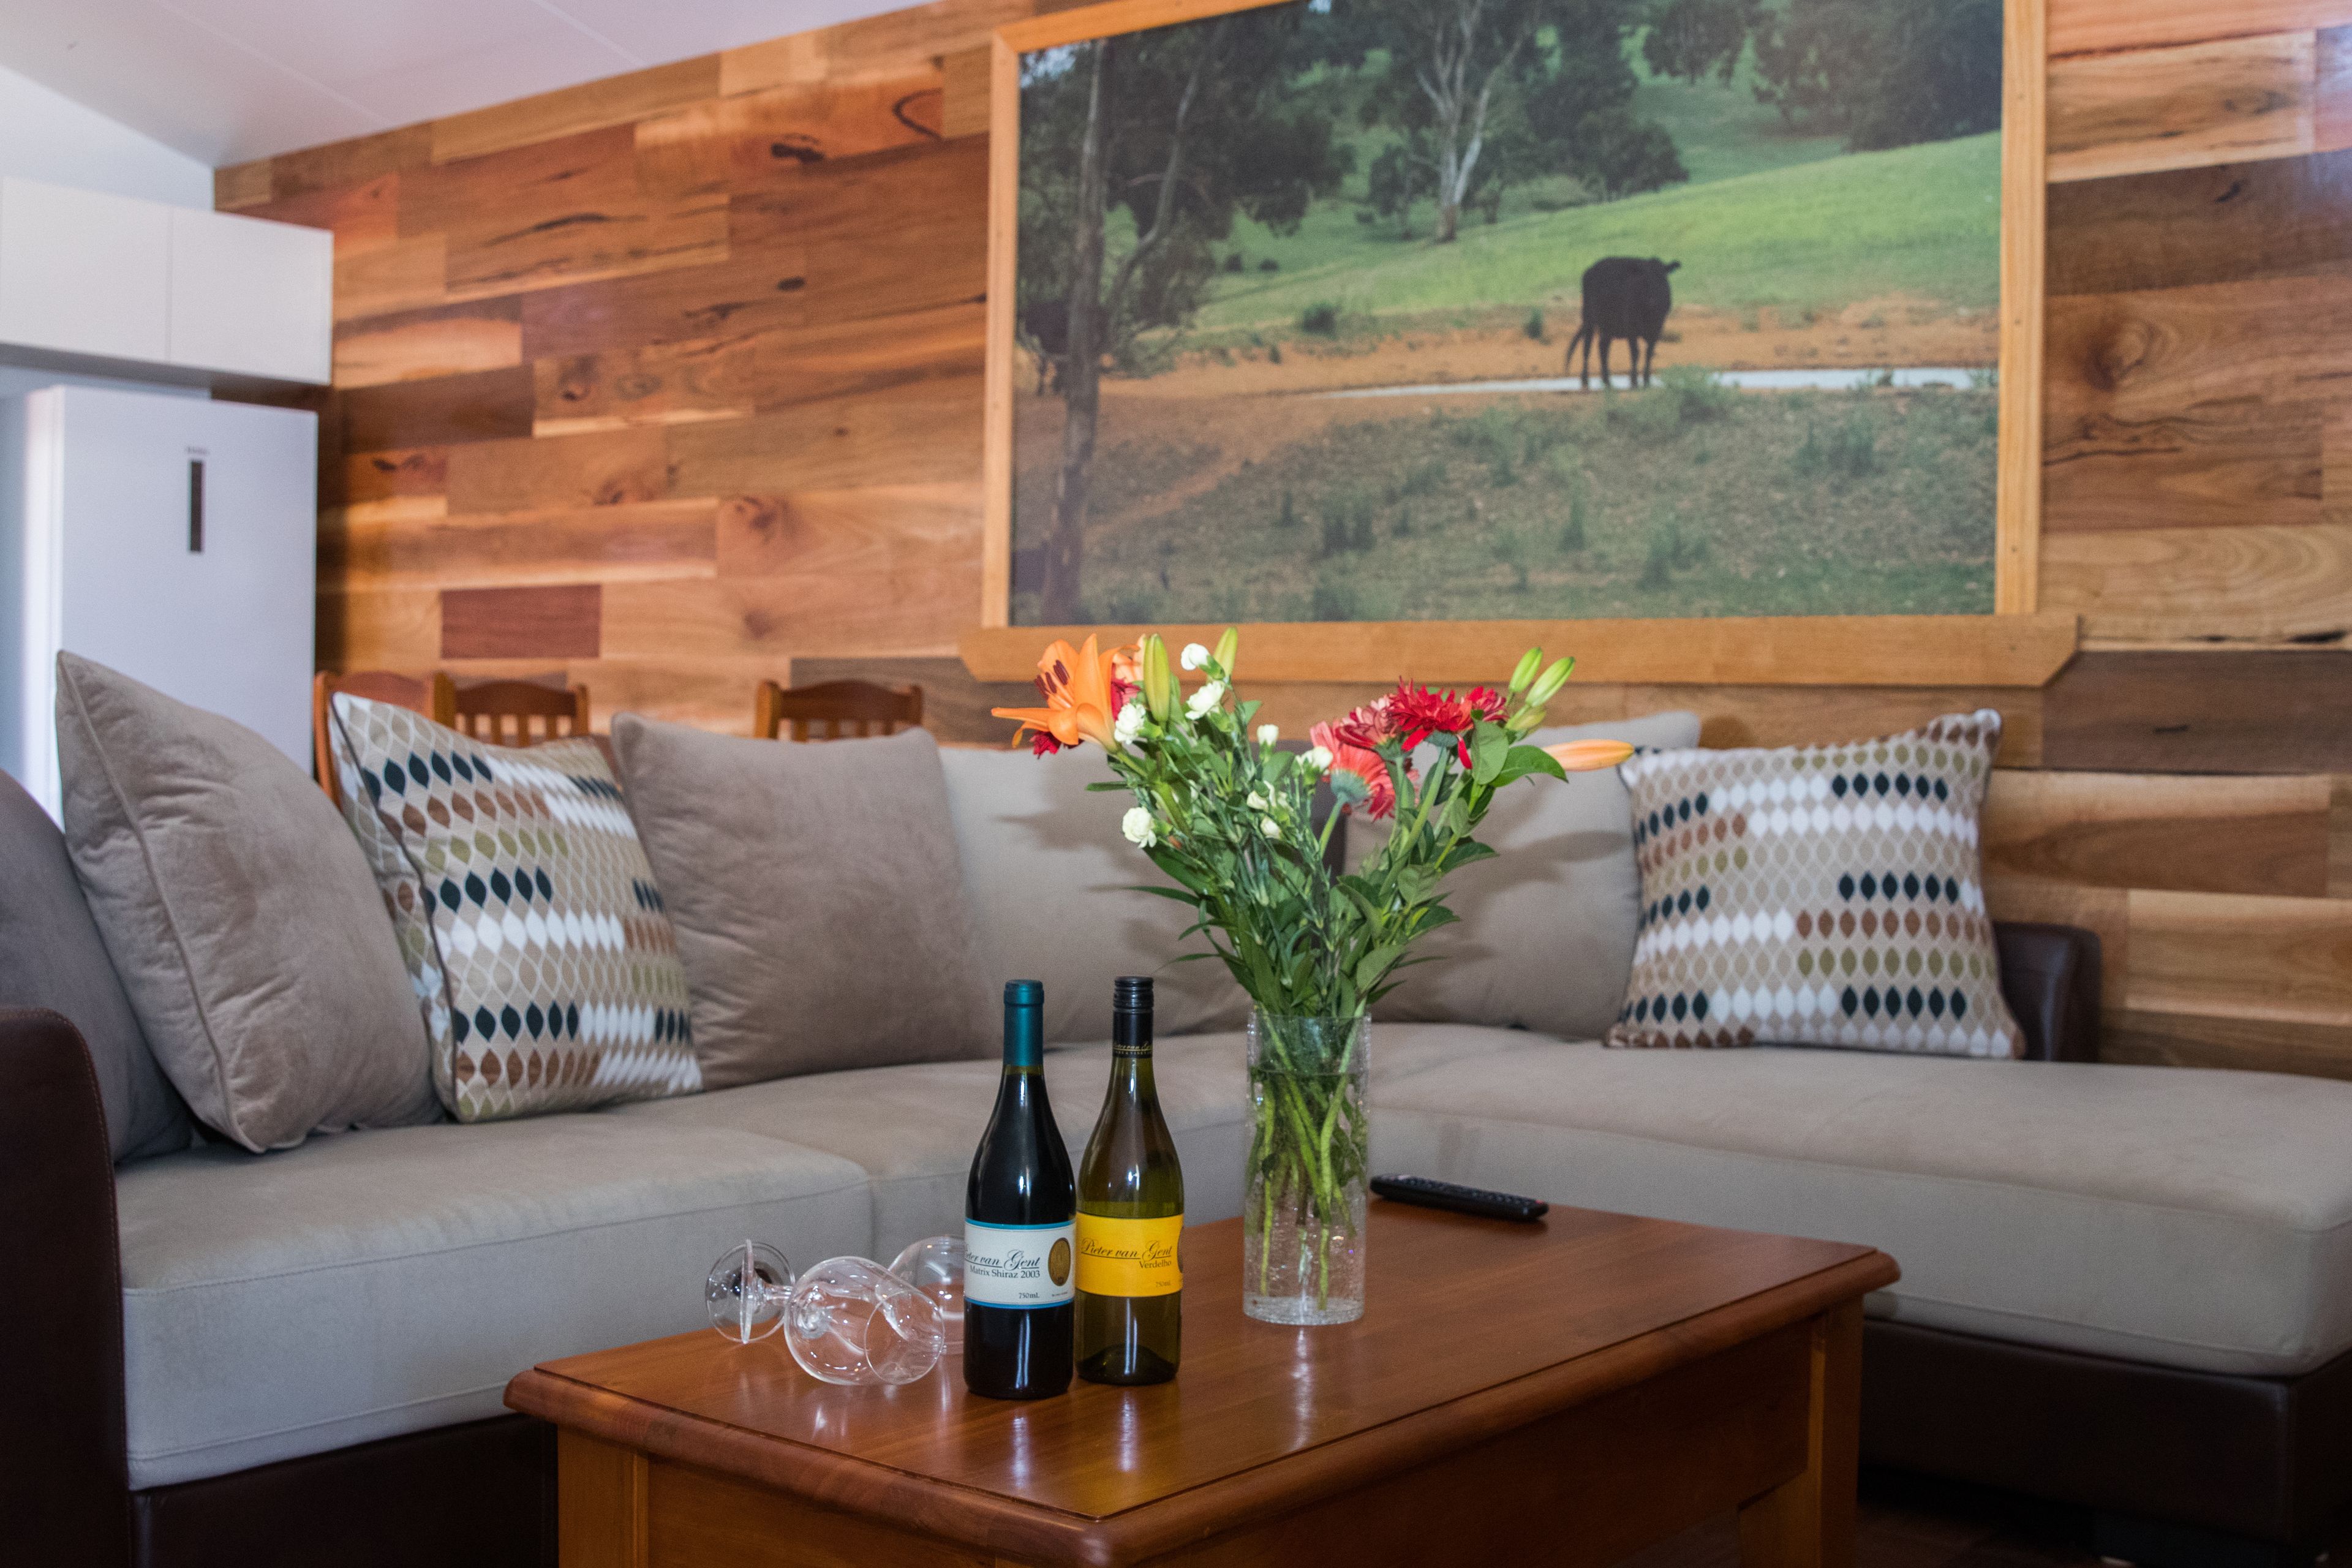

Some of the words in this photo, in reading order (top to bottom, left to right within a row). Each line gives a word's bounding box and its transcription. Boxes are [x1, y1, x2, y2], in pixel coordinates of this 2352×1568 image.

[1080, 1237, 1112, 1256] Pieter
[1142, 1240, 1173, 1262] Gent
[980, 1256, 1000, 1265] van
[1003, 1249, 1041, 1271] Gent
[1139, 1259, 1172, 1269] Verdelho
[970, 1265, 990, 1276] Matrix
[991, 1268, 1019, 1278] Shiraz
